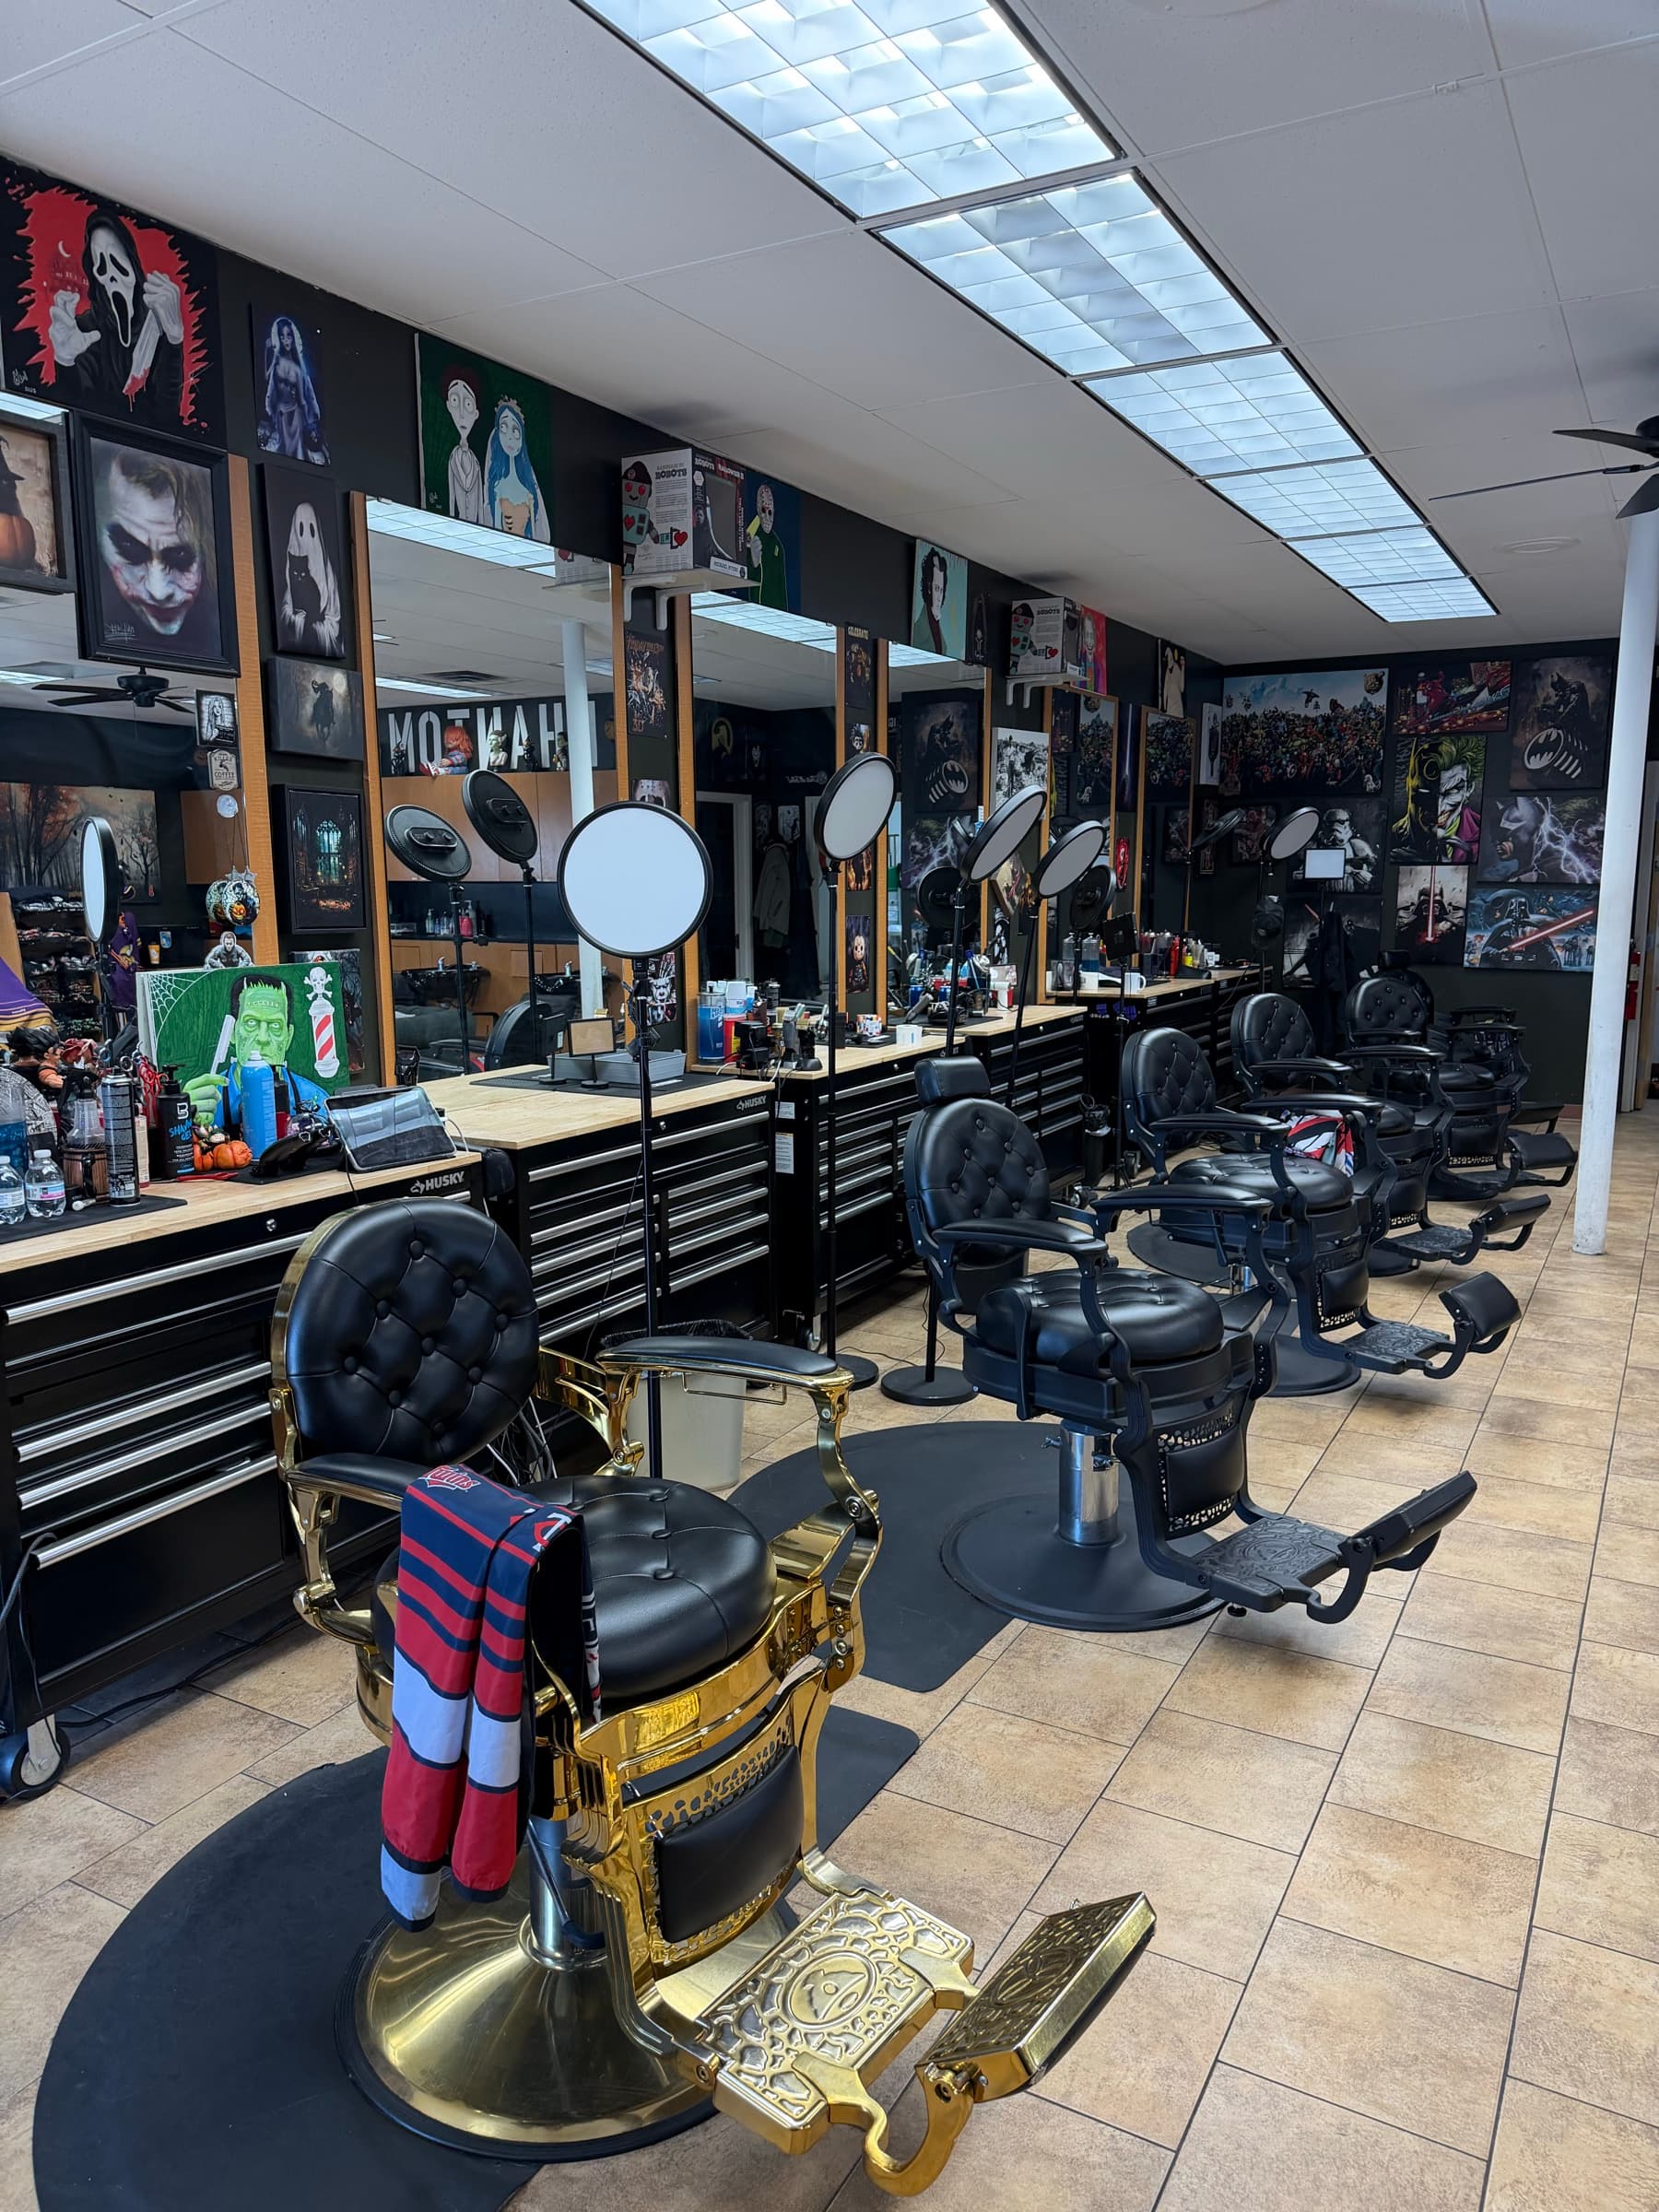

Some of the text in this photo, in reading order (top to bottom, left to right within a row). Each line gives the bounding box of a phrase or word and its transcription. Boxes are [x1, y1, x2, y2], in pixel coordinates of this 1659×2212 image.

[655, 468, 687, 479] ROBOTS
[745, 1095, 767, 1109] HUSKY
[425, 1171, 465, 1191] HUSKY
[418, 1465, 481, 1489] Twins
